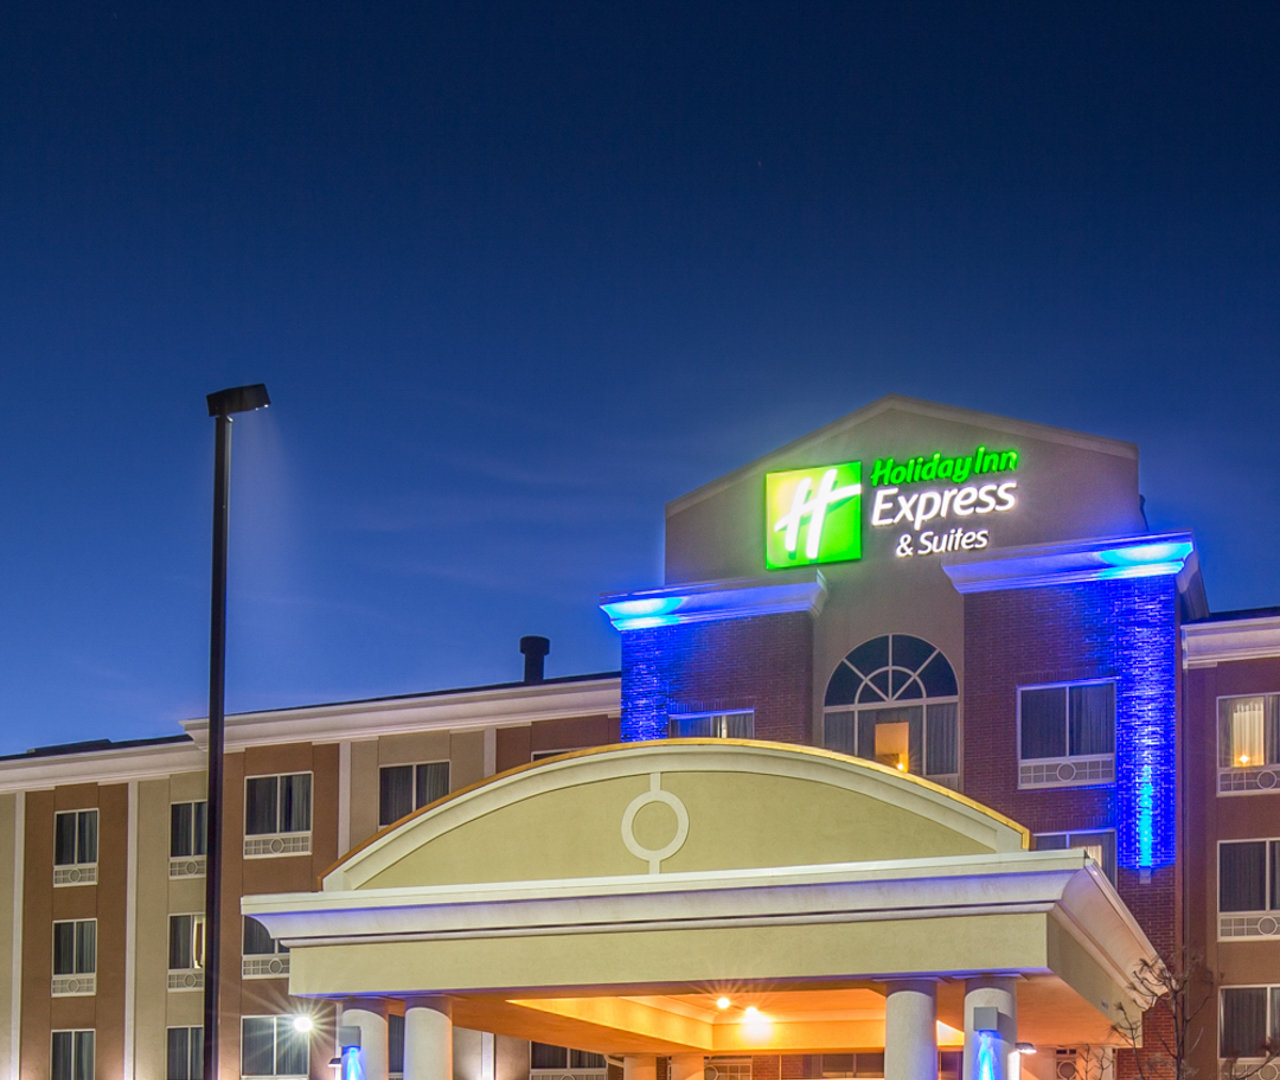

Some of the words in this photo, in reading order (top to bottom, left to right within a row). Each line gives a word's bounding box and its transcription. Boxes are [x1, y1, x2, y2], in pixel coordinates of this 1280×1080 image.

[871, 451, 972, 487] Holiday
[974, 445, 1019, 475] Inn
[871, 480, 1018, 531] Express
[895, 533, 913, 558] &
[917, 528, 989, 555] Suites
